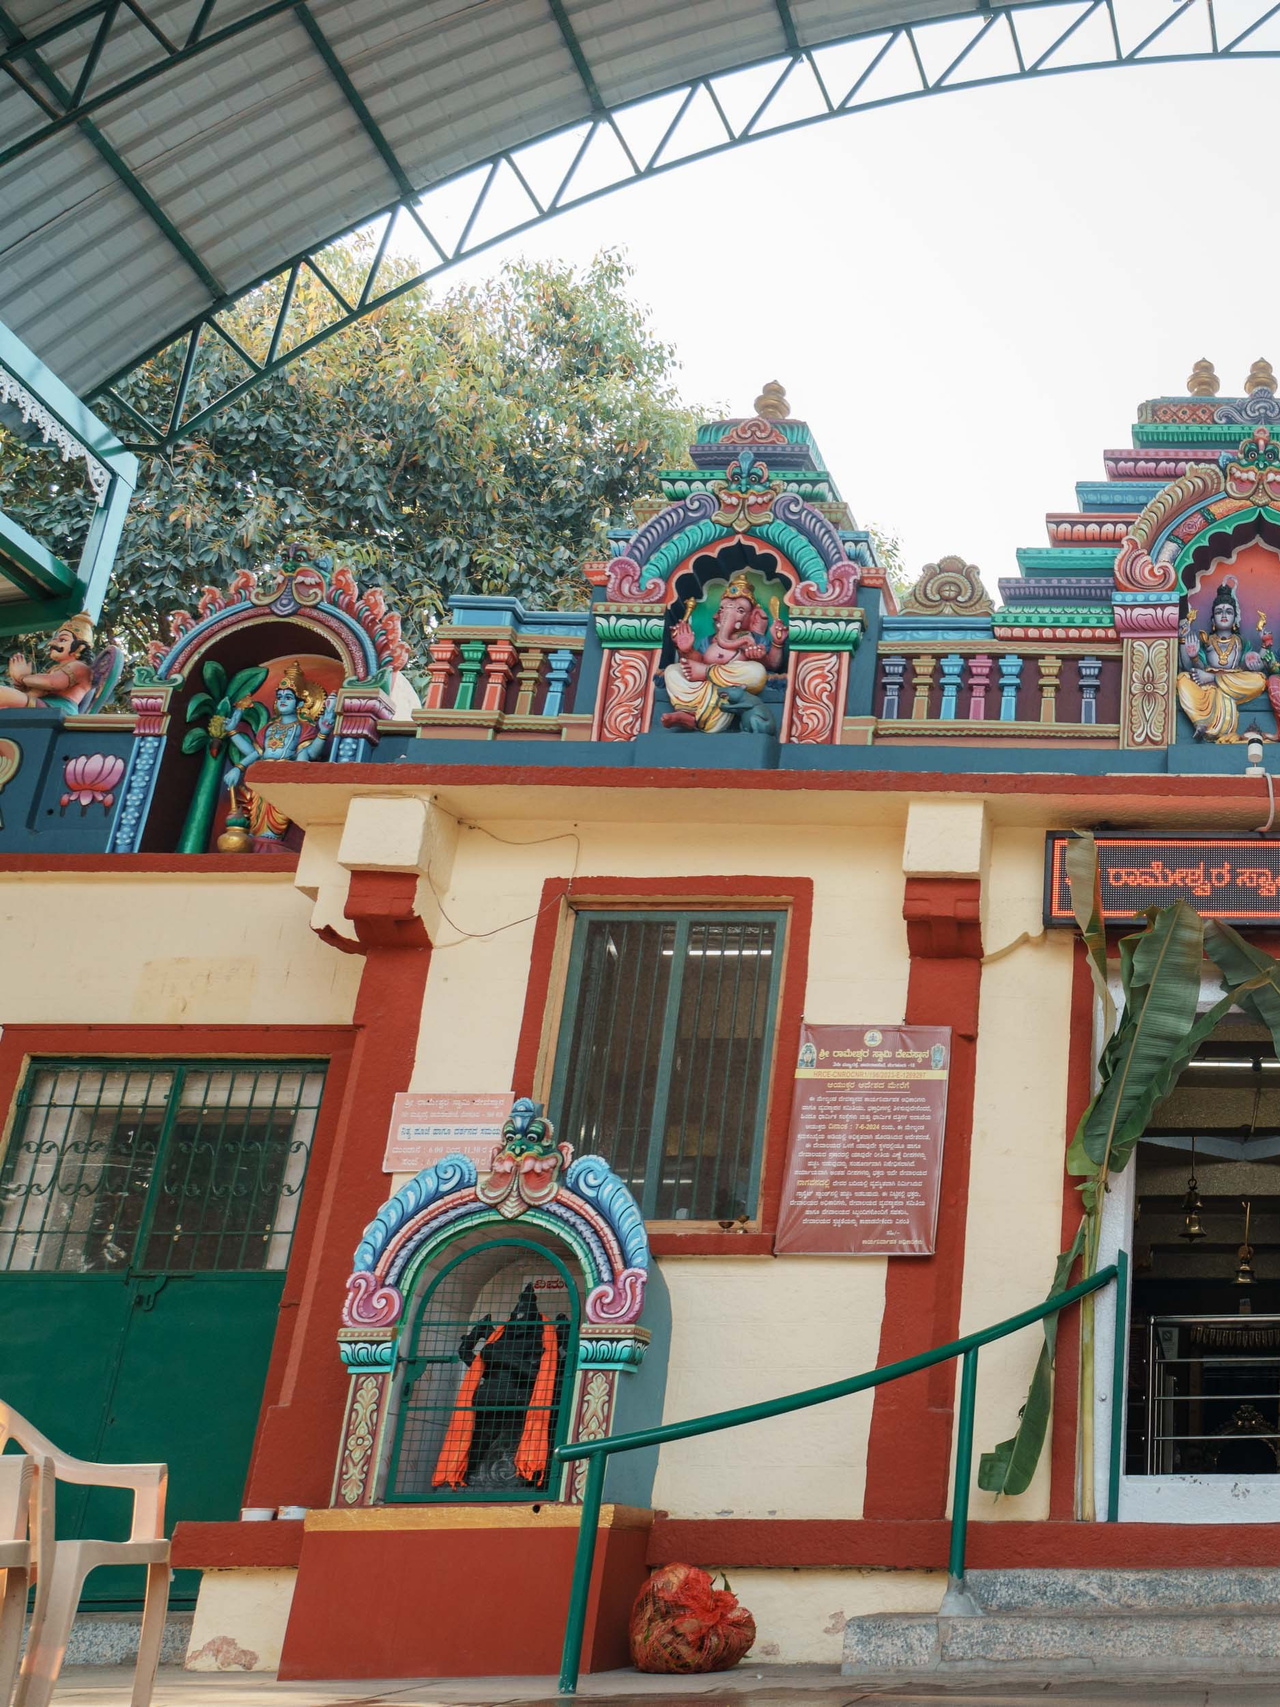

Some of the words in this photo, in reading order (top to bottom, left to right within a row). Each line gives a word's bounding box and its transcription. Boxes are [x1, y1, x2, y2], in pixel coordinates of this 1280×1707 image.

[1107, 861, 1231, 896] ರಾಮೇಶ್ವರ
[818, 1049, 830, 1060] ಶ್ರೀ
[832, 1048, 870, 1062] ರಾಮೇಶ್ವರ
[872, 1049, 892, 1062] ಸ್ವಾಮಿ
[895, 1049, 929, 1063] ದೇವಸ್ಥಾನ
